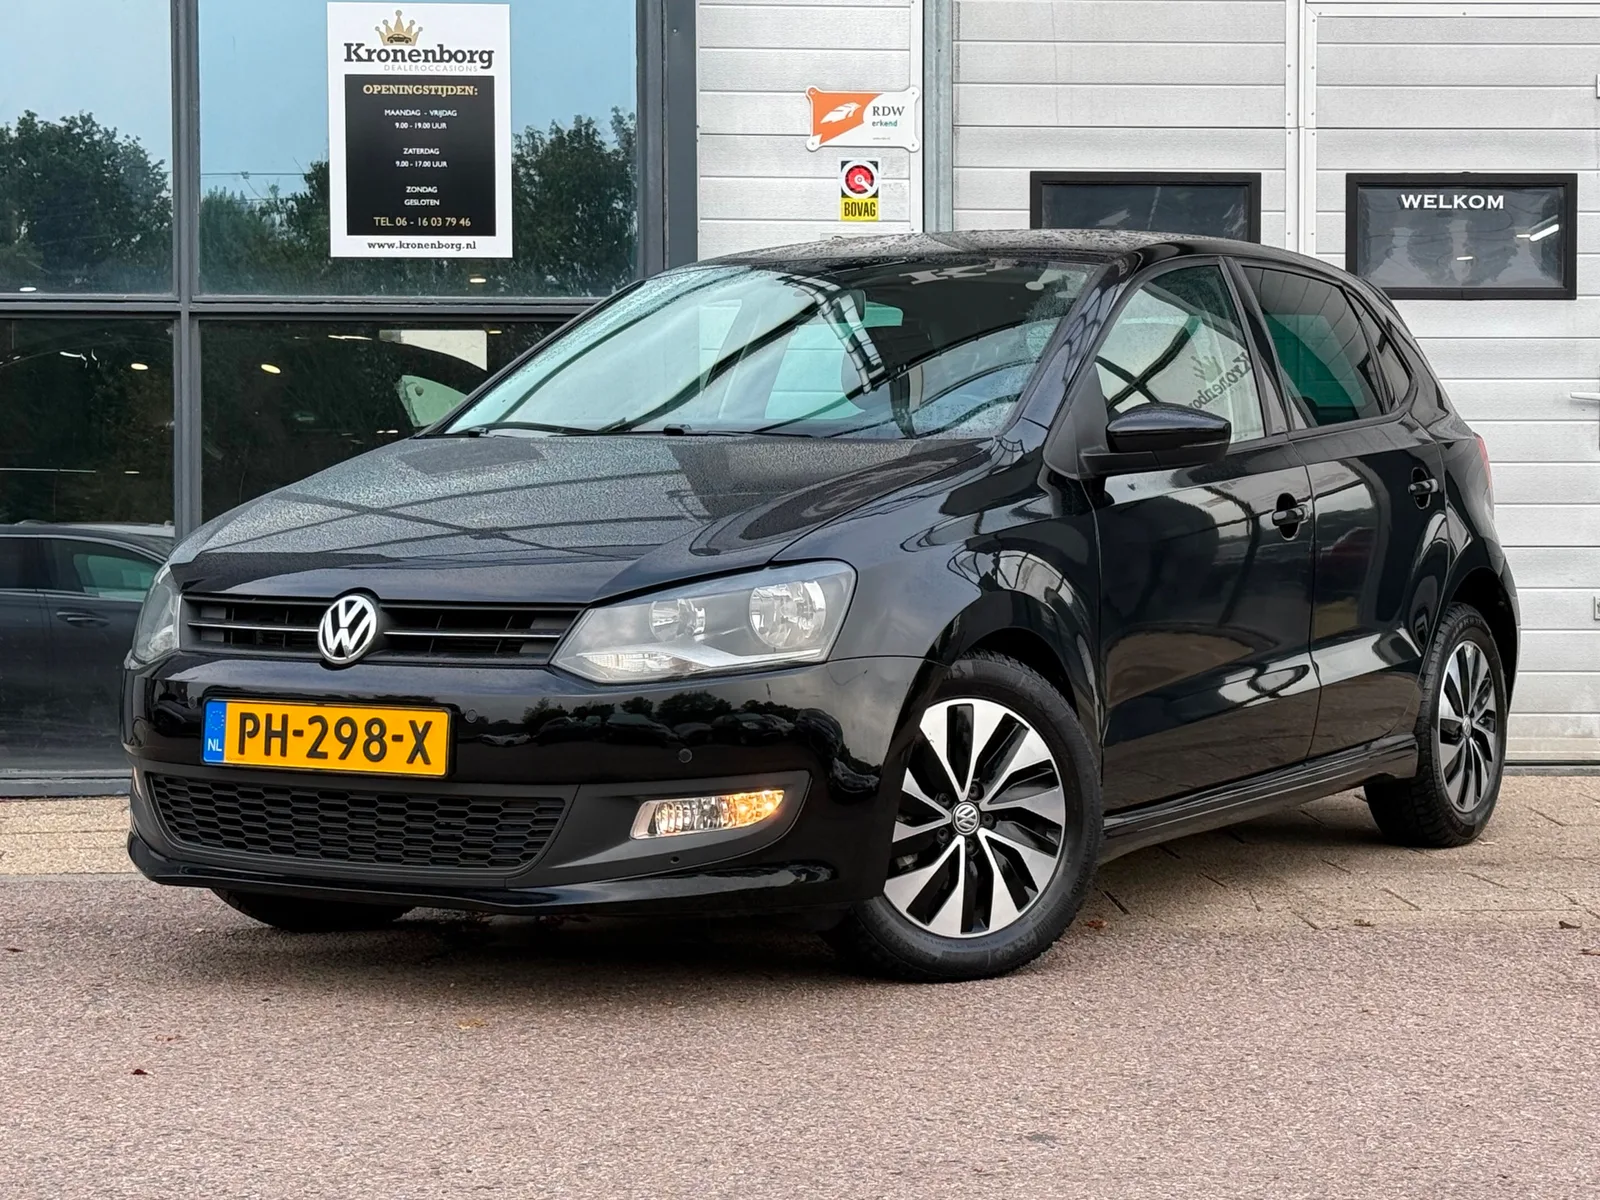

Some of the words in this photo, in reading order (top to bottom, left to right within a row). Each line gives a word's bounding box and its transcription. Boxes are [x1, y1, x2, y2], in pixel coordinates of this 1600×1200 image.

[344, 43, 494, 69] Kronenborg
[363, 85, 478, 97] OPENINGSTIJDEN:
[384, 109, 421, 117] MAANDAG
[429, 110, 458, 118] VRIJDAG
[872, 106, 905, 117] RDW
[1400, 194, 1504, 210] WELKOM
[844, 202, 876, 217] BOVAG
[395, 217, 408, 227] 06
[418, 217, 429, 227] 16
[430, 217, 442, 227] 03
[445, 217, 457, 227] 79
[459, 217, 471, 227] 46
[367, 240, 477, 252] www.kronenborg.nl
[207, 738, 223, 752] NL
[237, 711, 433, 766] PH-298-X
